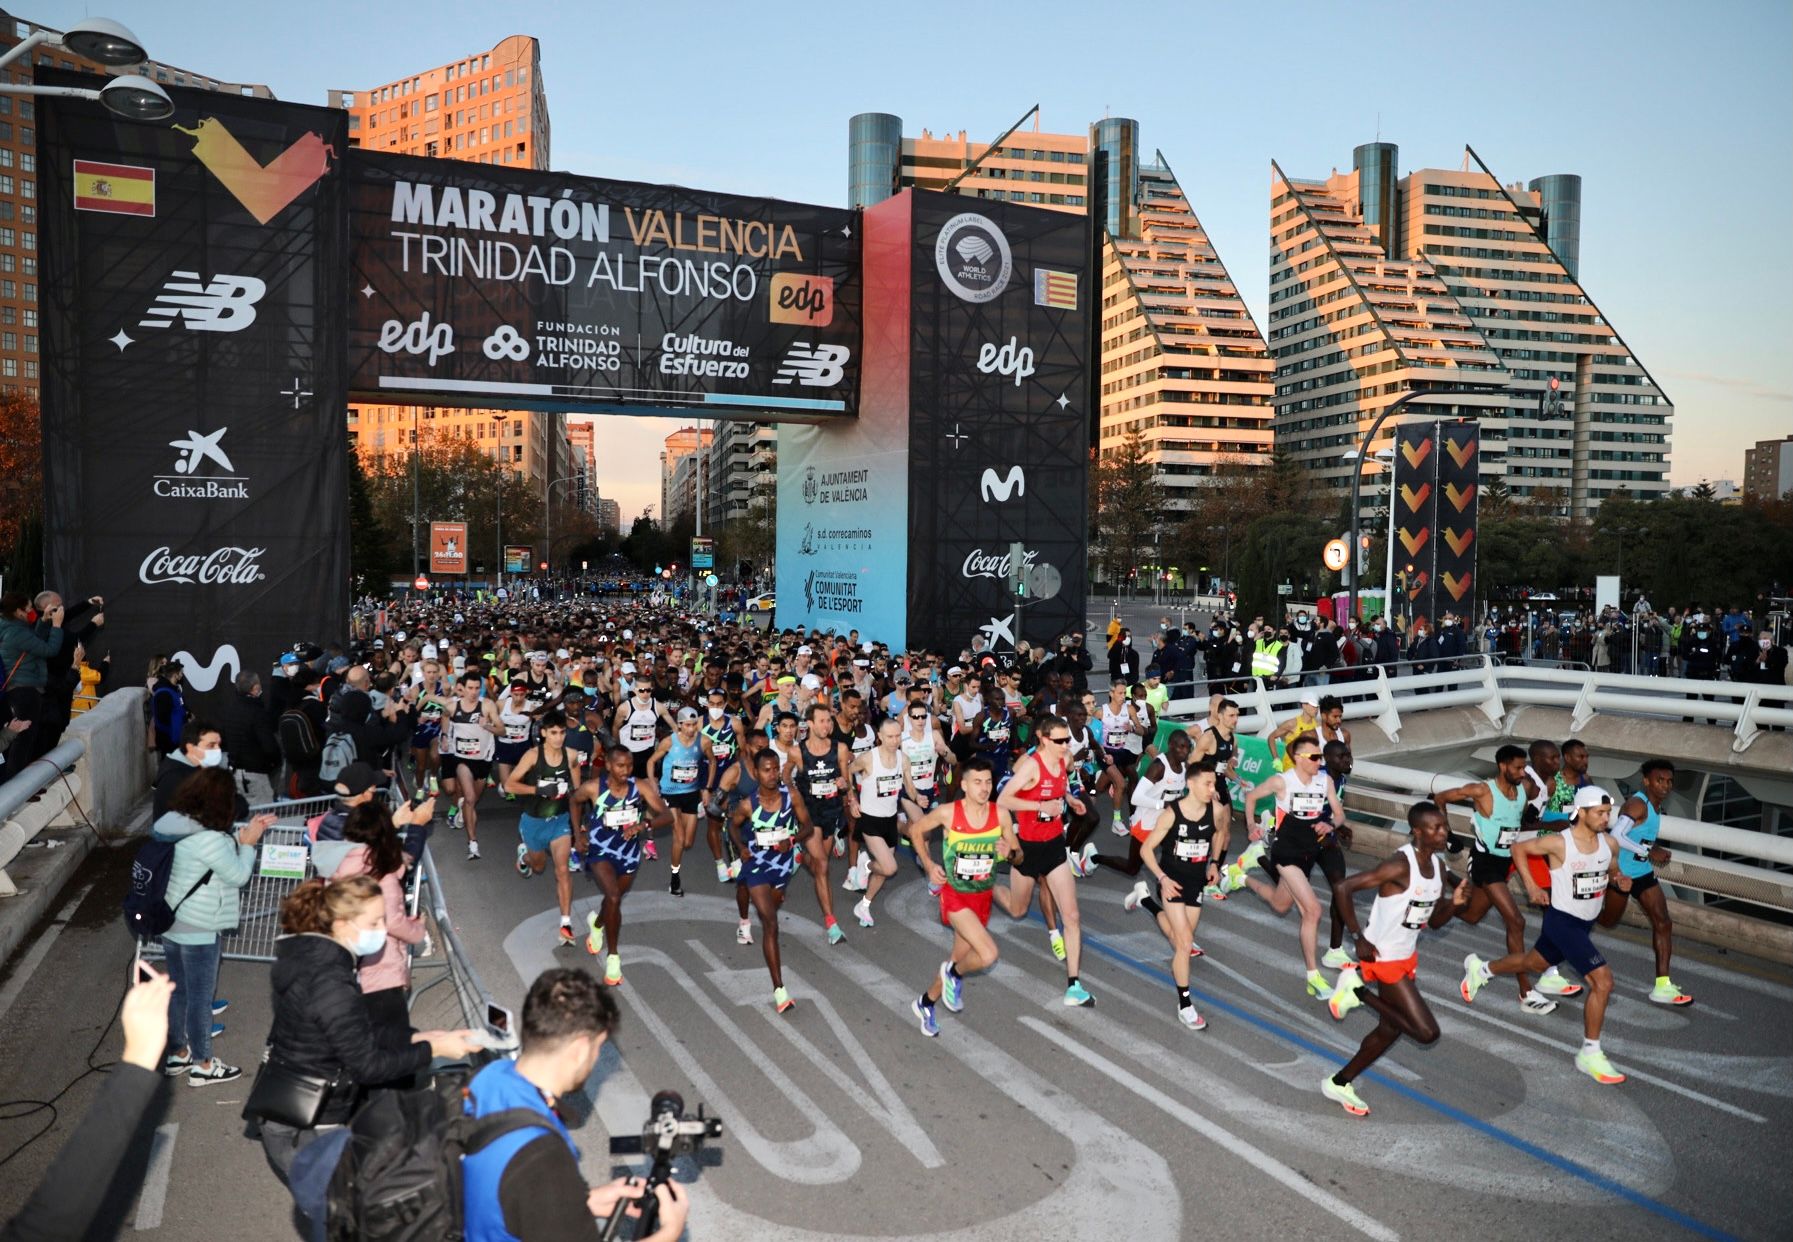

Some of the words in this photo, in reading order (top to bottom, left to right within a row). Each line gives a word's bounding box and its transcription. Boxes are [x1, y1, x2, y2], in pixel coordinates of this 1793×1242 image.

[391, 180, 610, 244] MARATÓN
[624, 207, 803, 262] VALENCIA
[391, 231, 576, 286] TRINIDAD
[587, 251, 757, 301] ALFONSO
[963, 264, 987, 275] WORLD
[957, 271, 992, 283] ATHLETICS
[778, 279, 825, 320] edp
[537, 321, 620, 337] FUNDACIÓN
[377, 310, 456, 367] edp
[536, 336, 621, 356] TRINIDAD
[662, 332, 733, 357] Cultura
[733, 346, 749, 358] del
[536, 353, 621, 372] ALFONSO
[659, 353, 750, 379] Esfuerzo
[976, 335, 1036, 387] edp
[820, 469, 869, 487] AJUNTAMENT
[153, 479, 250, 499] CaixaBank
[819, 491, 829, 504] DE
[817, 528, 828, 539] s.d.
[828, 527, 872, 539] correcaminos
[815, 581, 857, 597] COMUNITAT
[818, 596, 828, 609] DE
[828, 596, 863, 613] L'ESPORT
[1242, 757, 1263, 774] del
[956, 841, 994, 852] BIKILA
